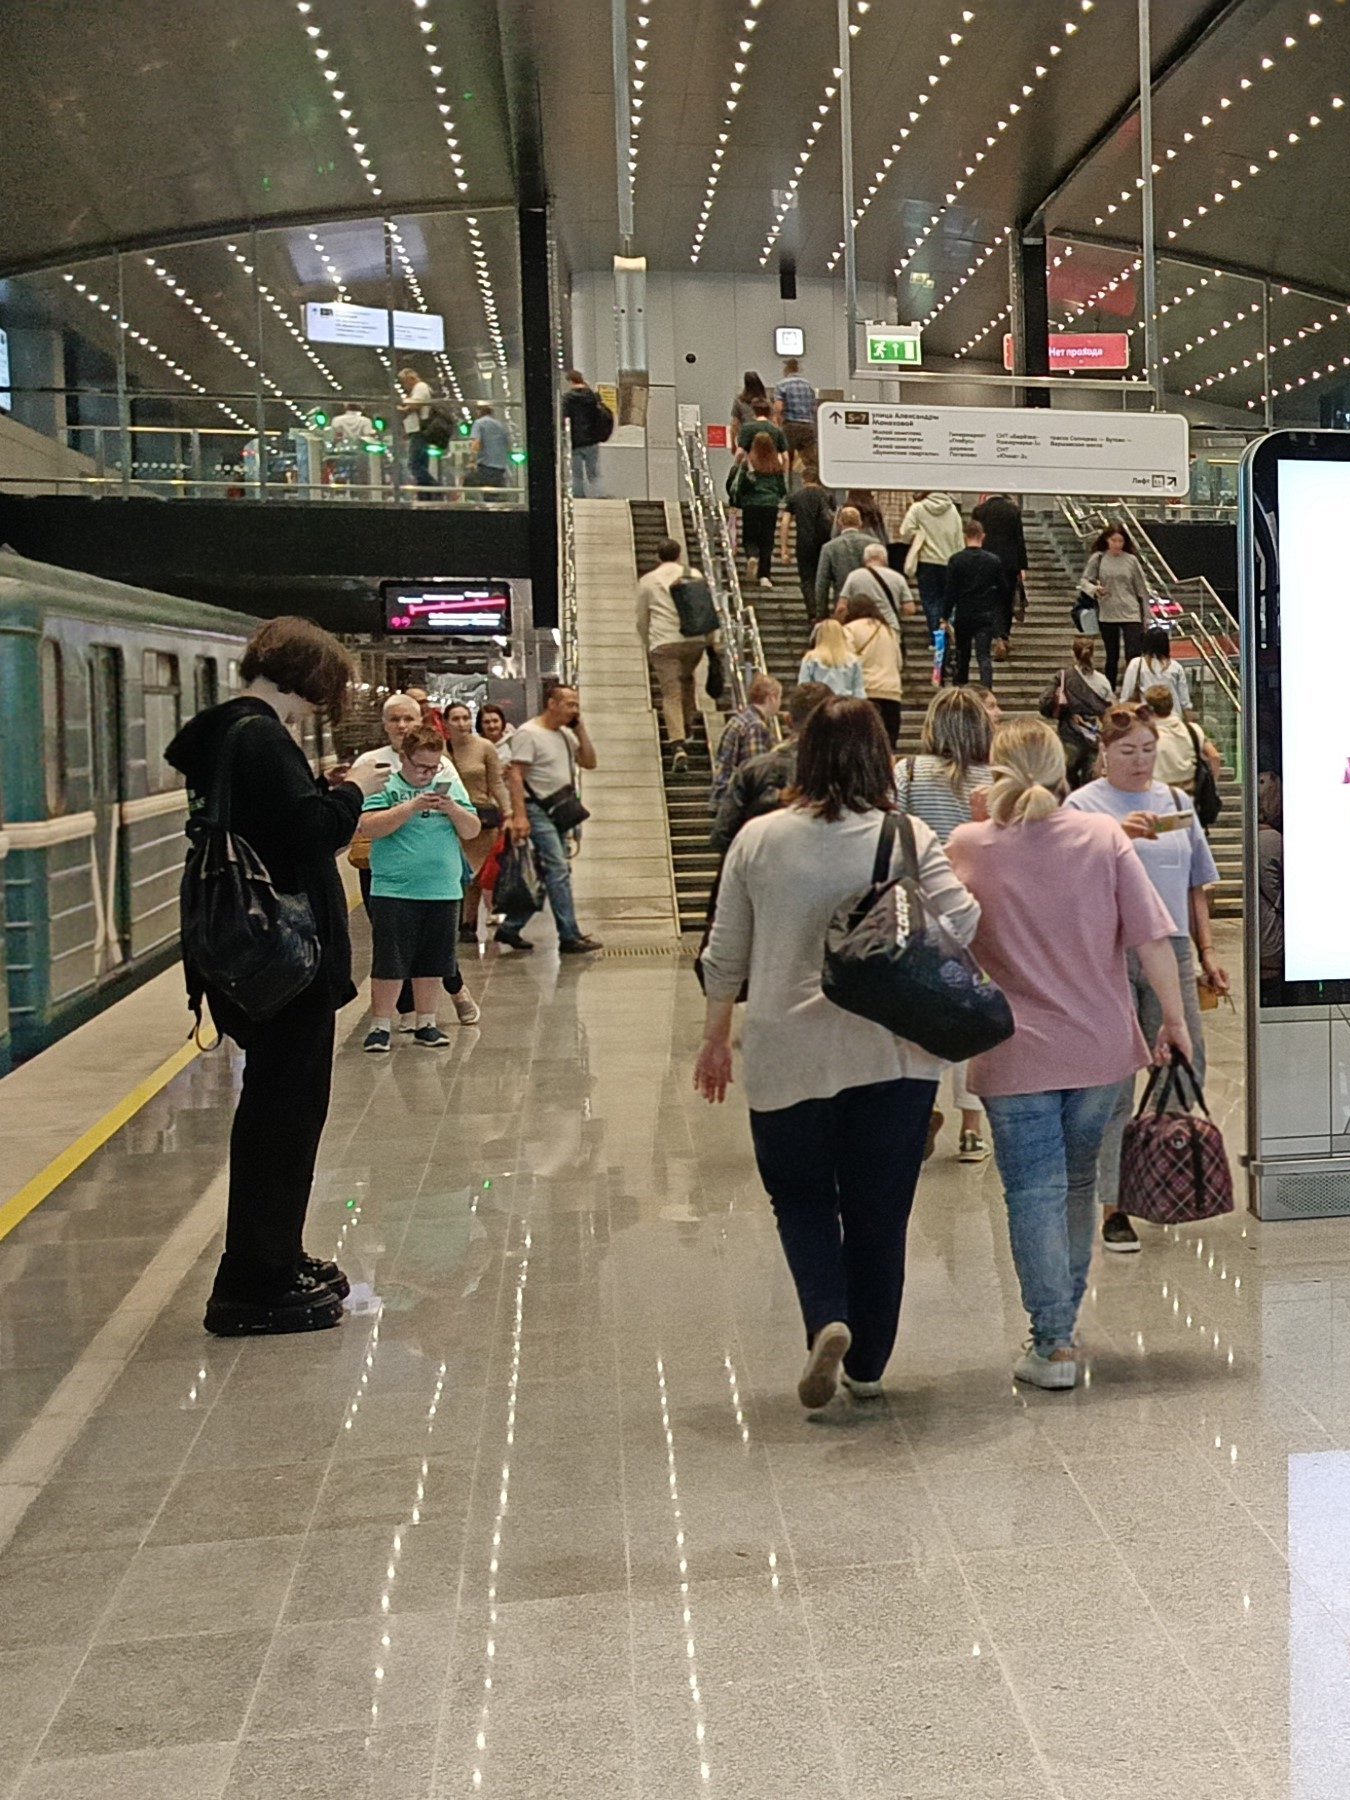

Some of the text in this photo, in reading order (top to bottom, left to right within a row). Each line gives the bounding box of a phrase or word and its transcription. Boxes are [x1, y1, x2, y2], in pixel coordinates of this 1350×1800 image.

[1048, 347, 1103, 358] Нет прохода
[1132, 477, 1150, 485] Лифт
